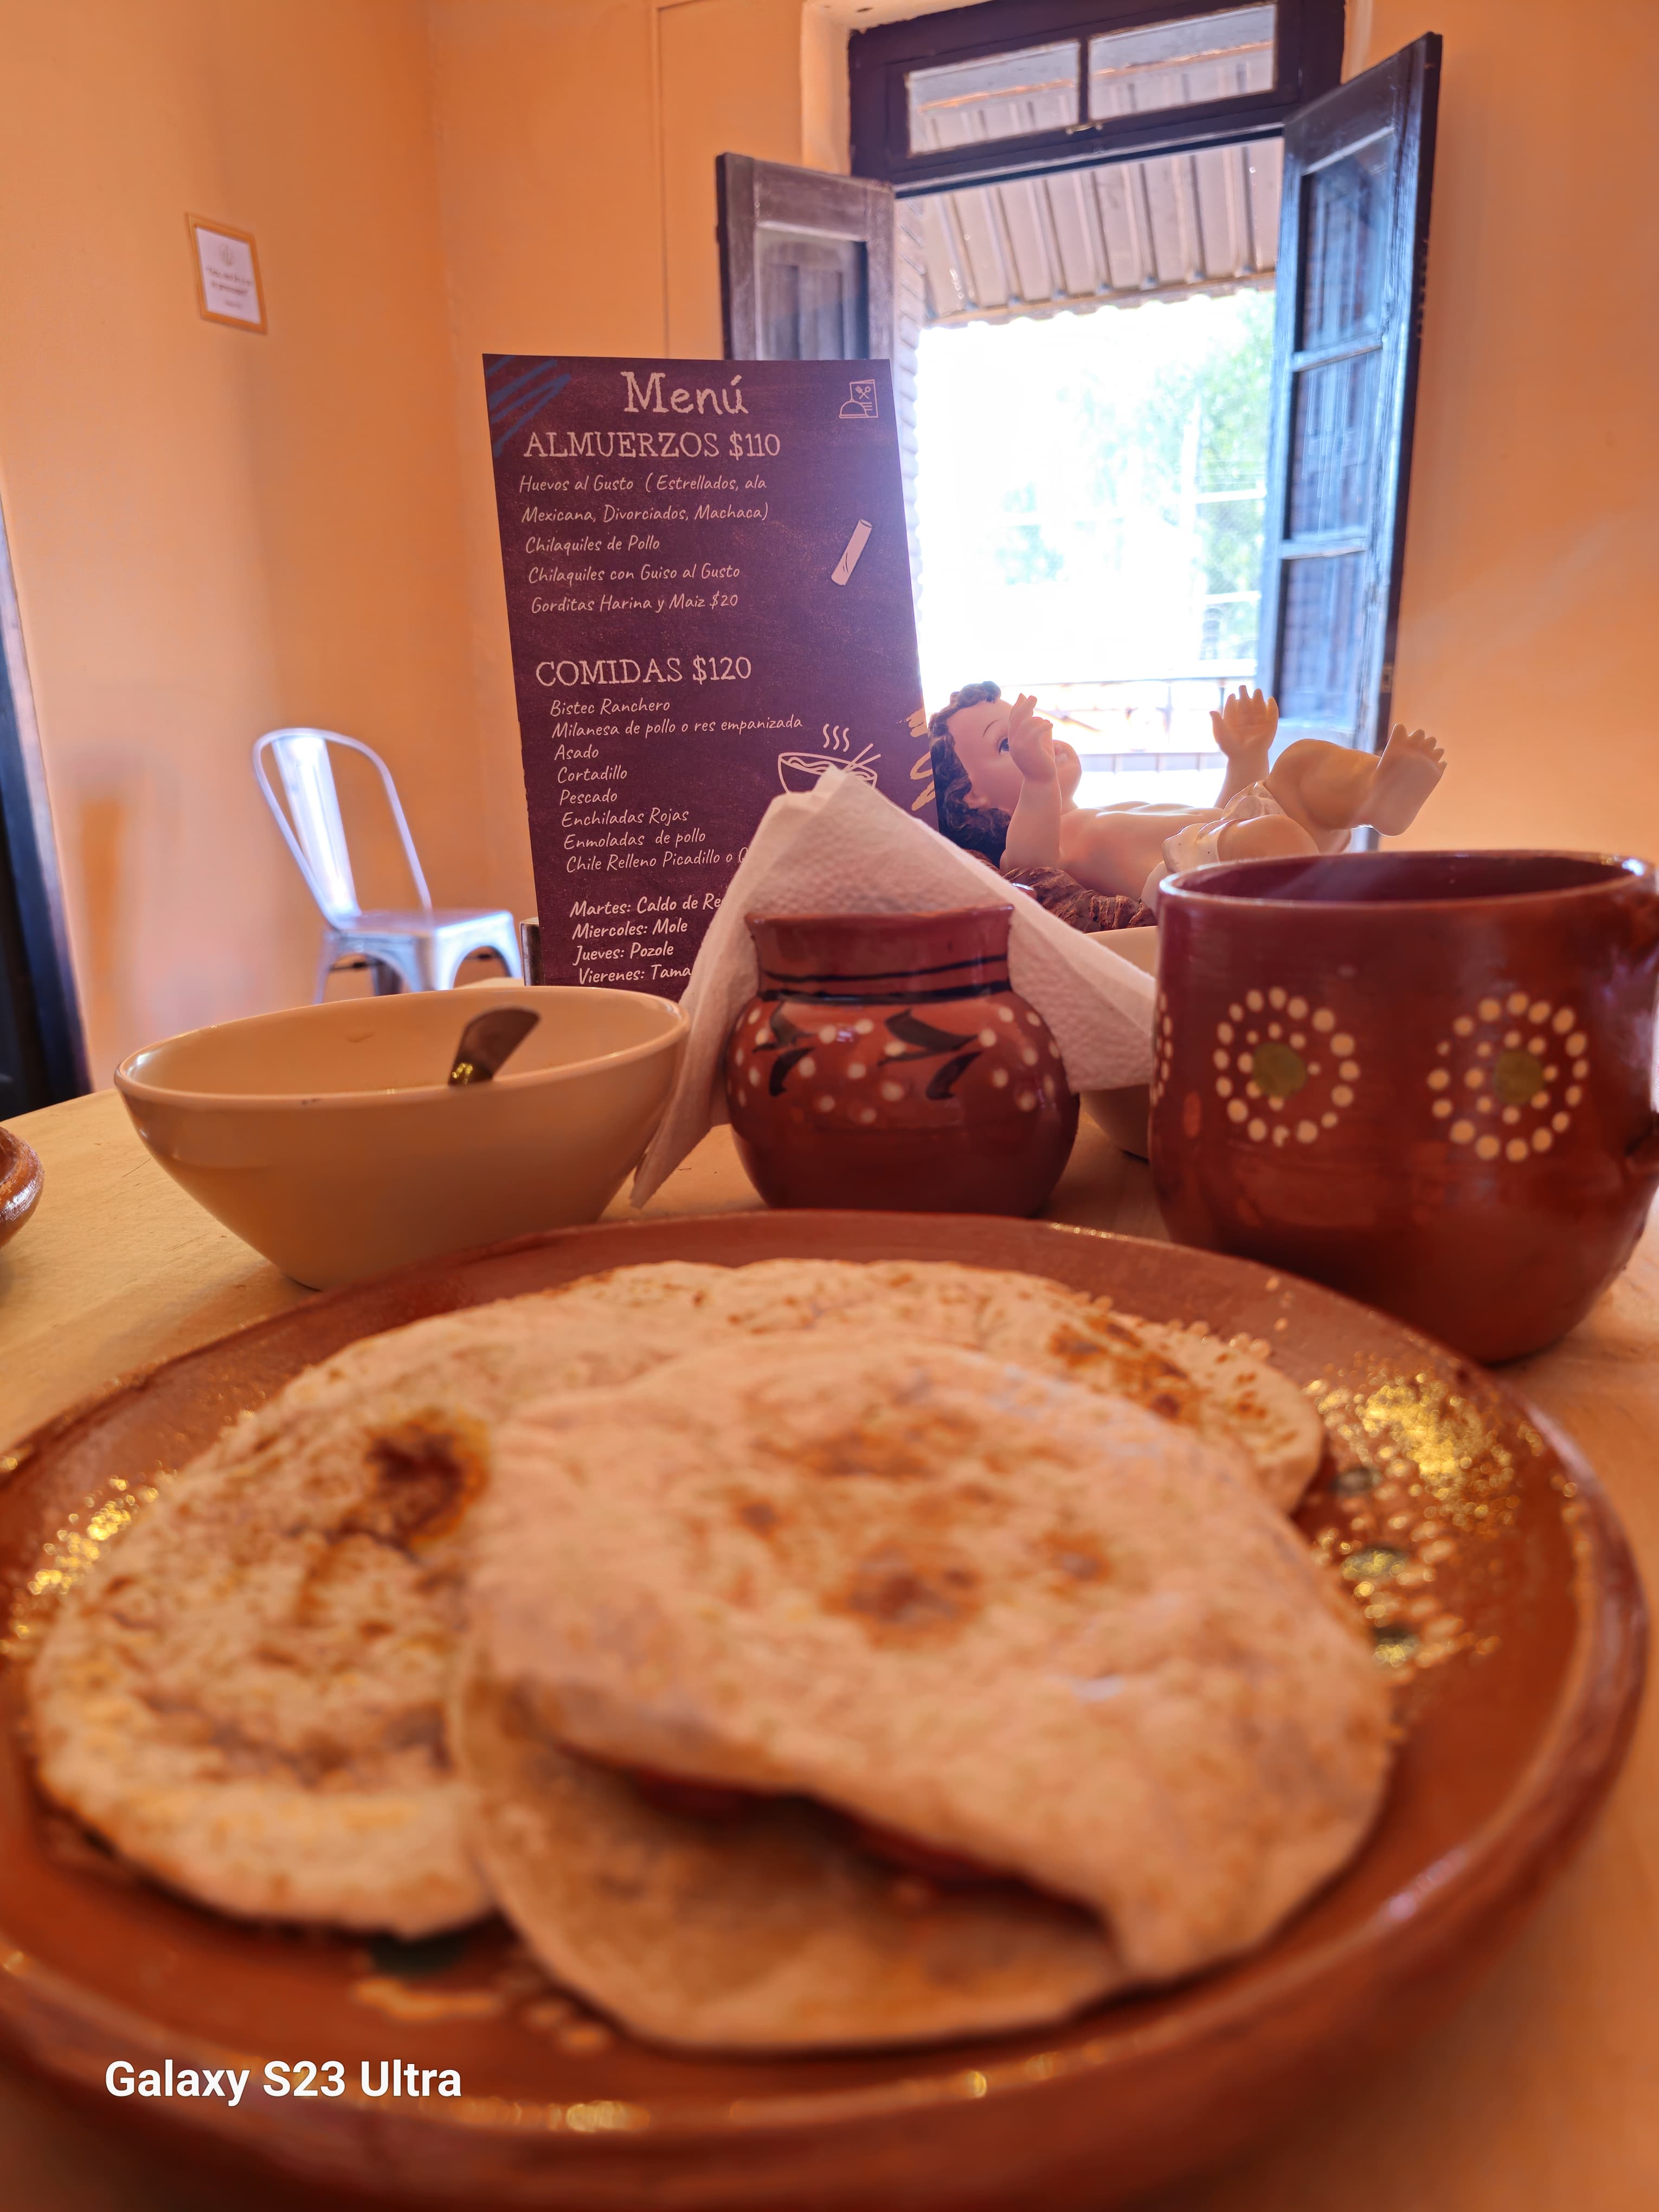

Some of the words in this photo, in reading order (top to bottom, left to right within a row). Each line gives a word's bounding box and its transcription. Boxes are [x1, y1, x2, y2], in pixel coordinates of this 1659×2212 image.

[620, 371, 748, 414] Menú
[524, 432, 719, 458] ALMUERZOS
[730, 431, 780, 460] $110
[519, 475, 569, 493] Huevos
[575, 475, 589, 490] al
[594, 475, 633, 491] Gusto
[657, 475, 738, 490] Estrellados,
[745, 475, 767, 488] ala
[522, 507, 596, 523] Mexicana,
[603, 505, 689, 523] Divorciados,
[695, 502, 768, 520] Machaca)
[526, 536, 602, 556] Chilaquiles
[607, 536, 622, 551] de
[628, 535, 659, 551] Pollo
[529, 566, 605, 587] Chilaquiles
[610, 571, 634, 580] con
[641, 564, 677, 580] Guiso
[683, 564, 696, 578] al
[702, 563, 740, 578] Gusto
[532, 597, 594, 613] Gorditas
[600, 594, 652, 612] Harina
[655, 600, 664, 613] y
[669, 593, 705, 609] Maiz
[710, 591, 737, 609] $20
[536, 658, 683, 686] COMIDAS
[693, 655, 751, 685] $120
[550, 700, 594, 716] Bistec
[600, 697, 670, 715] Ranchero
[552, 722, 620, 738] Milanesa
[626, 720, 640, 735] de
[645, 718, 676, 738] pollo
[681, 723, 689, 732] o
[695, 722, 716, 731] res
[722, 714, 802, 735] empanizada
[554, 744, 599, 760] Asado
[558, 765, 627, 783] Cortadillo
[560, 788, 617, 806] Pescado
[562, 809, 644, 827] Enchiladas
[649, 807, 689, 826] Rojas
[564, 832, 645, 850] Enmoladas
[655, 829, 670, 844] de
[676, 827, 705, 848] pollo
[567, 856, 601, 872] Chile
[607, 853, 656, 871] Relleno
[663, 849, 719, 867] Picadillo
[726, 853, 733, 863] o
[570, 901, 631, 917] Martes:
[637, 896, 677, 914] Caldo
[683, 895, 698, 909] de
[703, 893, 721, 910] Re
[572, 921, 648, 940] Miercoles:
[653, 917, 687, 935] Mole
[573, 946, 625, 966] Jueves:
[630, 941, 673, 959] Pozole
[580, 968, 645, 984] Vierenes:
[651, 964, 692, 980] Tama
